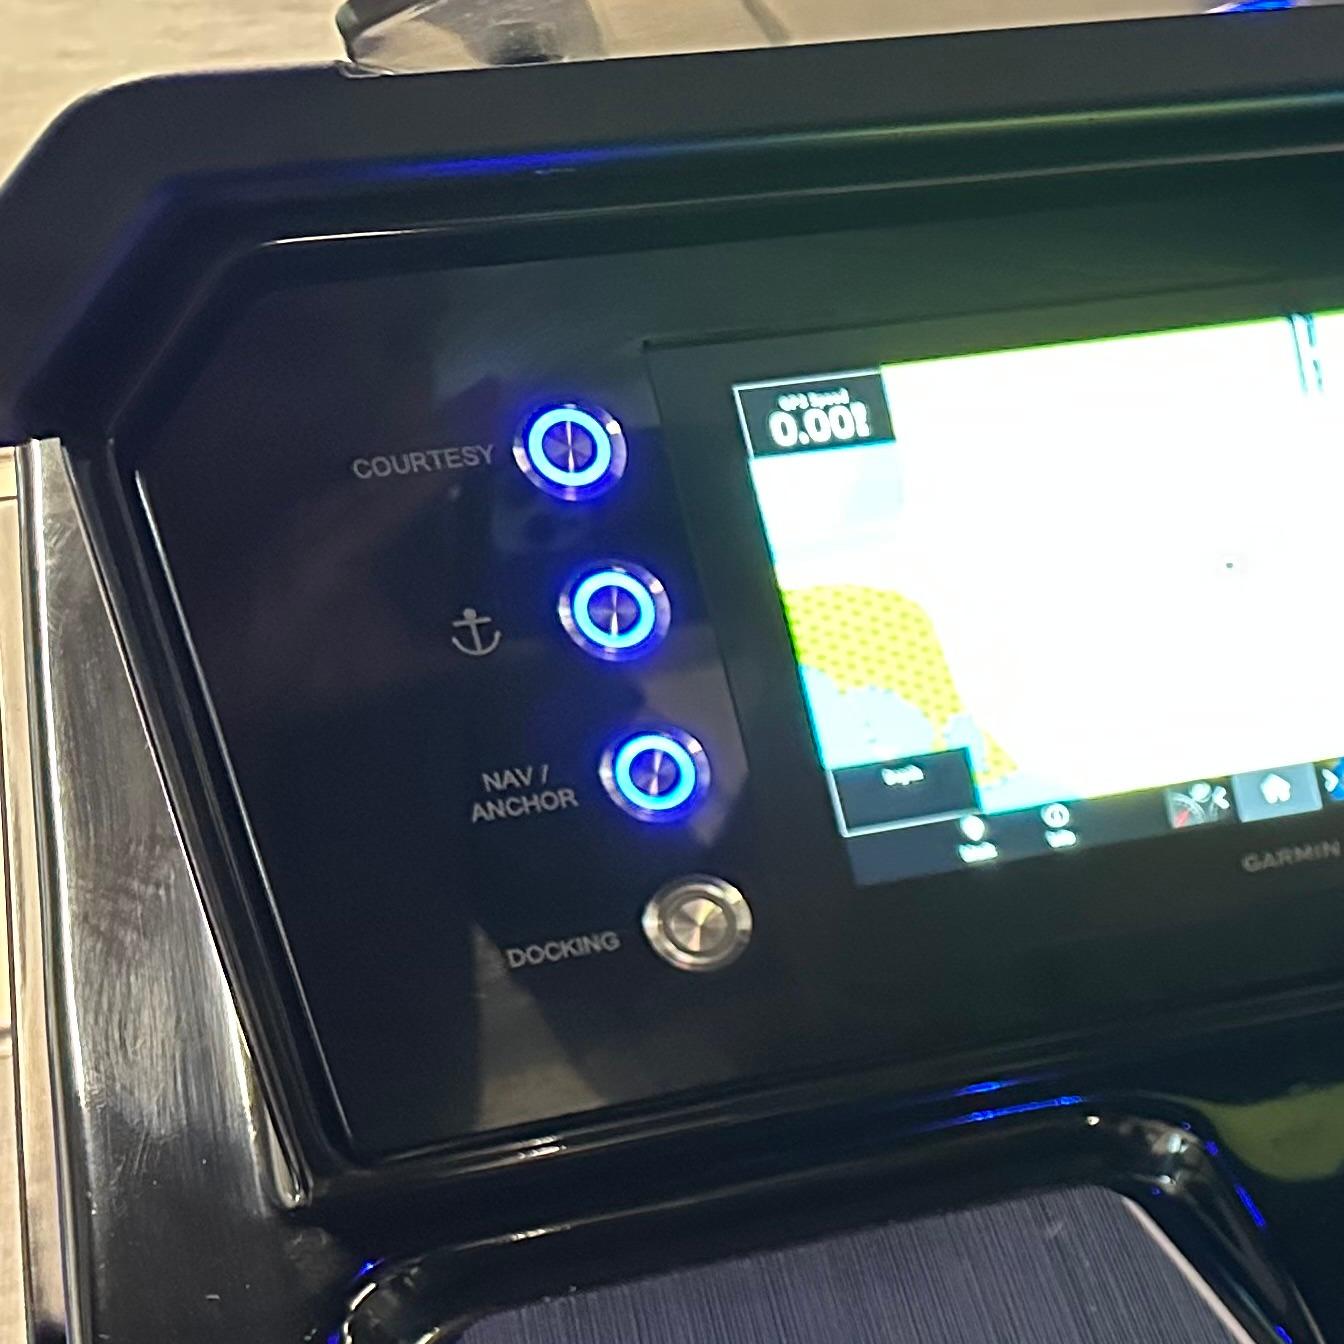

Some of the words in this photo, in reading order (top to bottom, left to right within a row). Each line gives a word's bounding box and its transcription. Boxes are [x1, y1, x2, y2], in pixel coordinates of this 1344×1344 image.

[352, 444, 495, 480] COURTESY
[482, 766, 533, 794] NAV
[470, 787, 580, 825] ANCHOR
[1241, 840, 1341, 872] GARMIN
[506, 930, 621, 970] DOCKING
